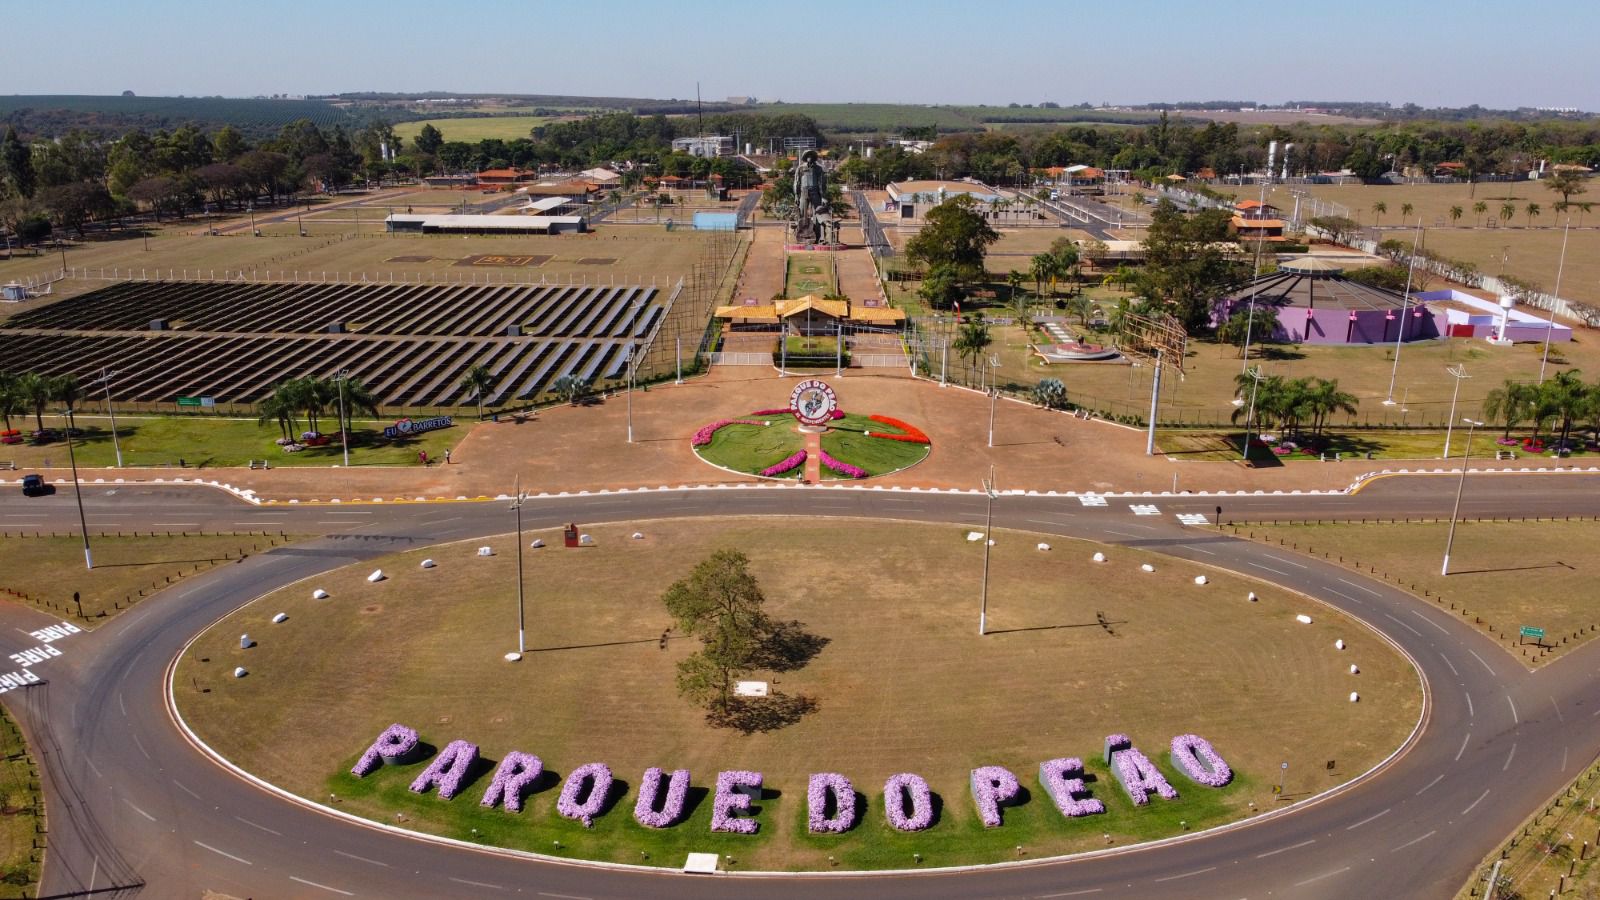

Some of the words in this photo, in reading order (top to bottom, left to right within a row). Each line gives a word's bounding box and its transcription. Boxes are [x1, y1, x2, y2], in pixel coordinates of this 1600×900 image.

[790, 381, 811, 410] PARQUE
[813, 381, 826, 390] DO
[386, 428, 397, 436] EU
[412, 418, 451, 431] BARRETOS
[30, 621, 82, 643] PARE
[8, 643, 63, 667] PARE
[350, 723, 763, 834] PARQUE
[807, 773, 933, 833] DO
[970, 733, 1233, 828] PEÃO
